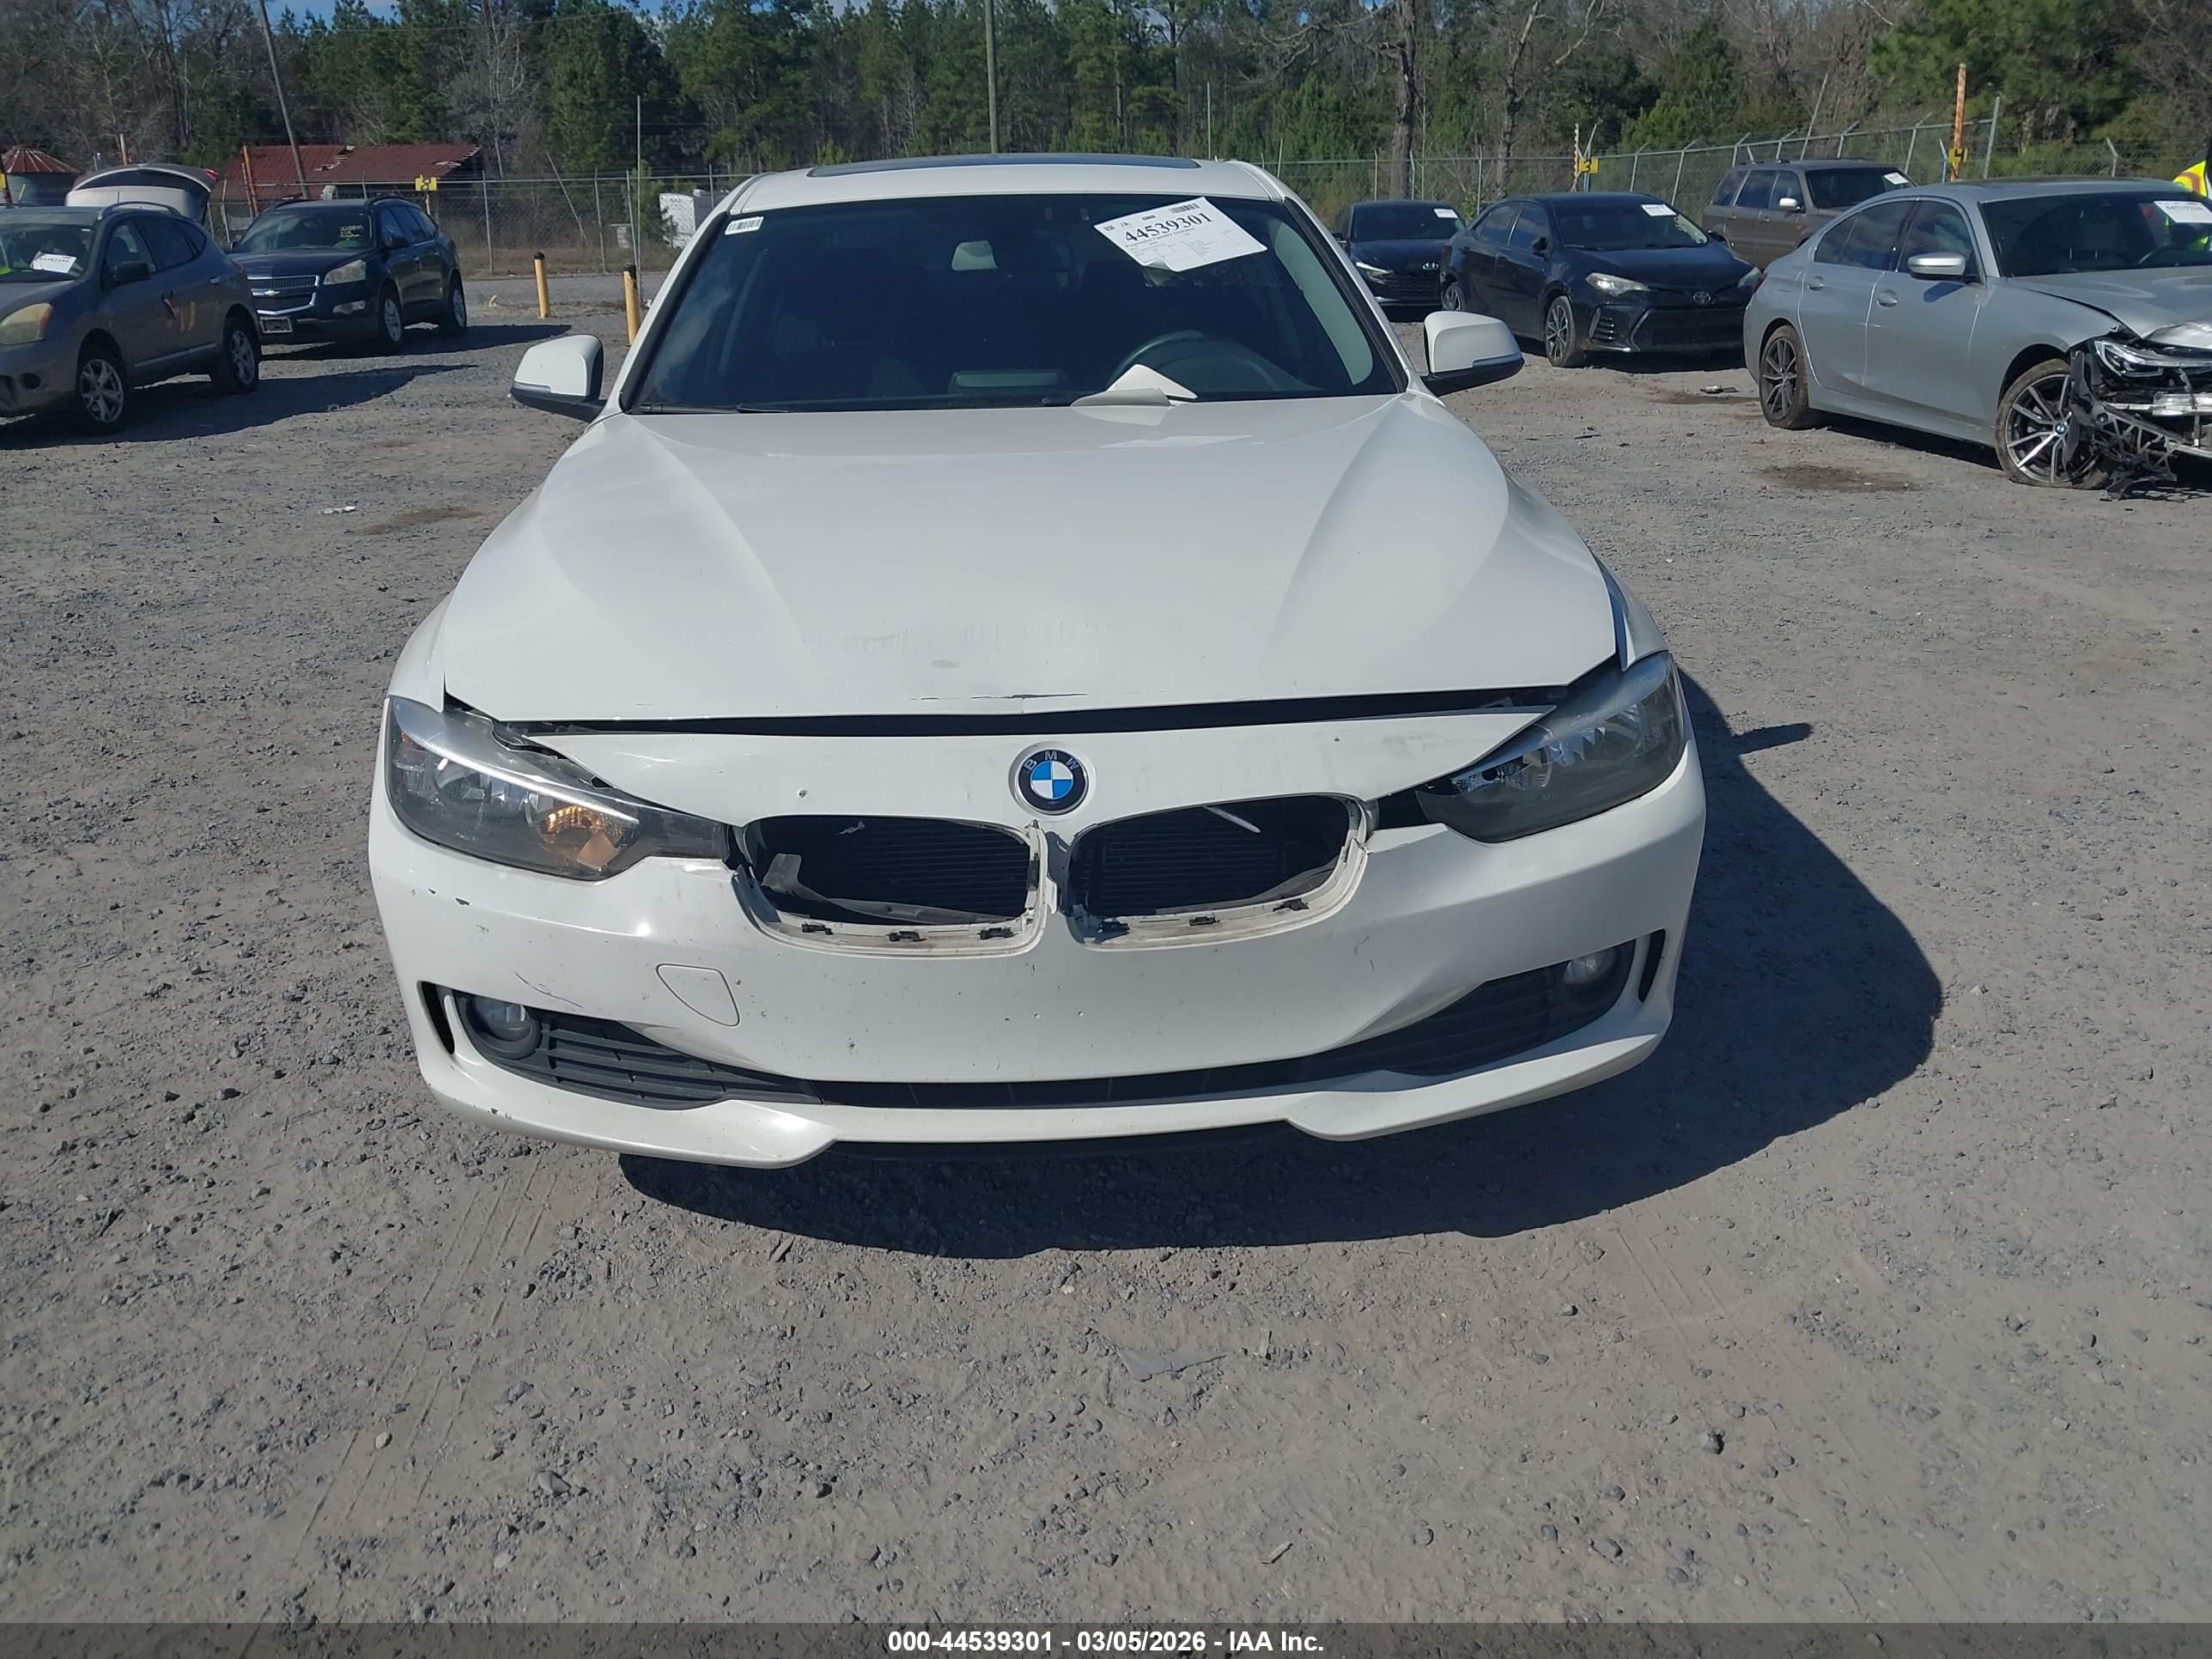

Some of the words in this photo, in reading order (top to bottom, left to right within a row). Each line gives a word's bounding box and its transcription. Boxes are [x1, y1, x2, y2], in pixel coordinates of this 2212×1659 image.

[1954, 148, 1965, 162] 4
[1582, 159, 1592, 173] 3
[1124, 212, 1213, 242] 44539301
[1023, 750, 1080, 771] BMW
